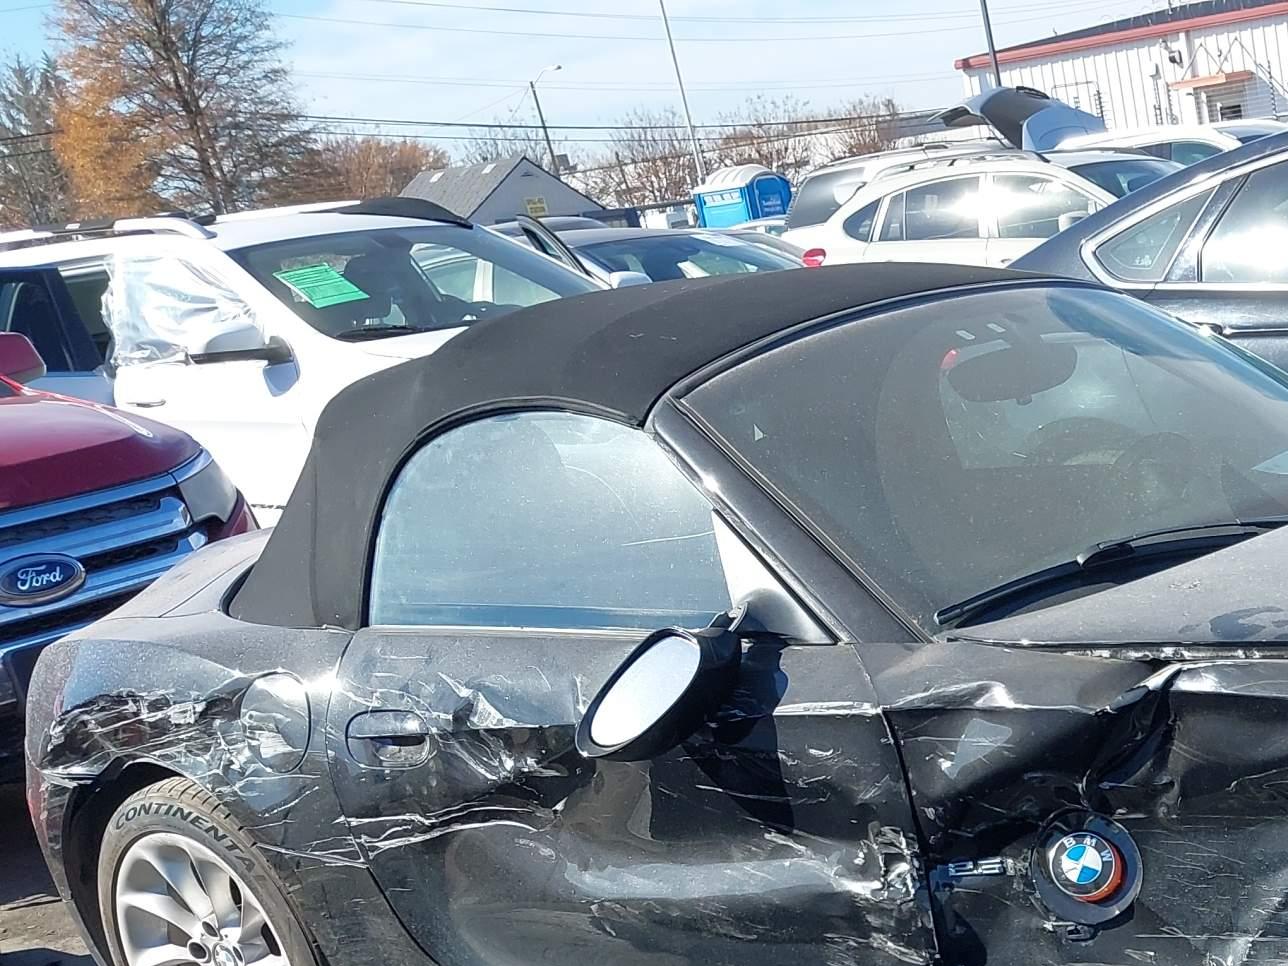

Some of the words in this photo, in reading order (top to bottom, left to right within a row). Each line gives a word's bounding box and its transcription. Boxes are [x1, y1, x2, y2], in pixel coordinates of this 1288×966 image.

[17, 565, 65, 591] Ford
[115, 801, 267, 884] CONTINENTAL
[1063, 834, 1113, 863] BMW
